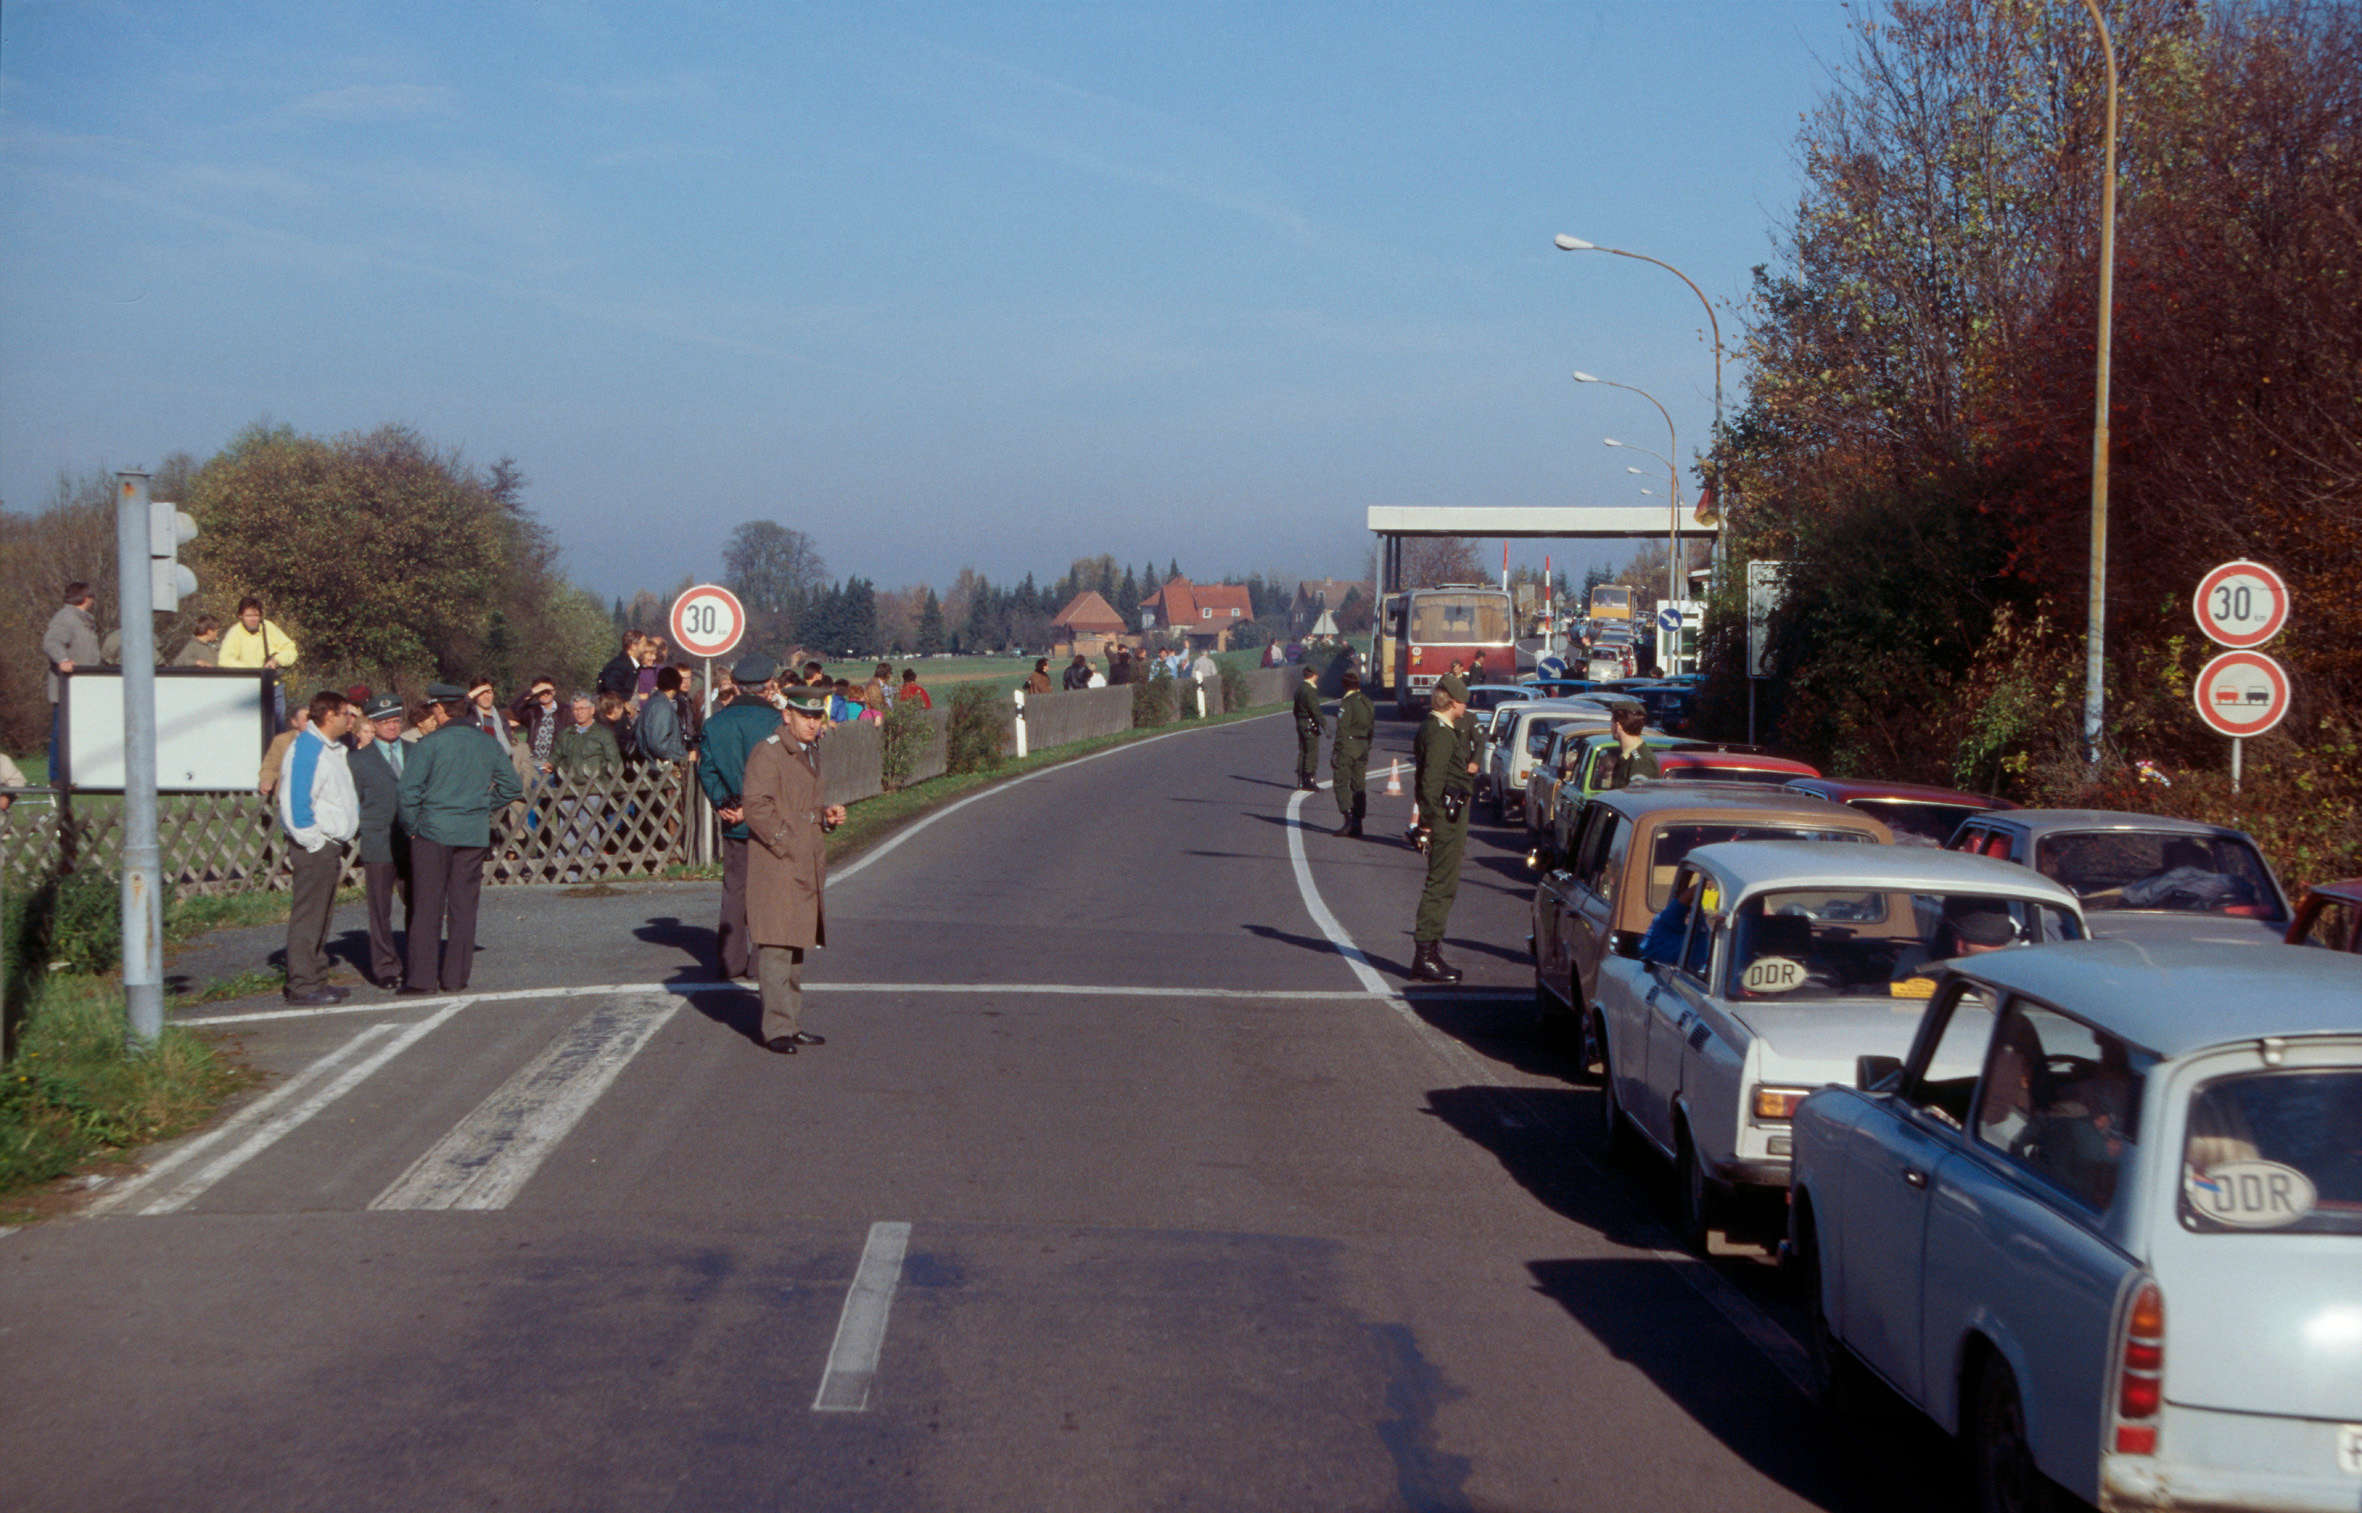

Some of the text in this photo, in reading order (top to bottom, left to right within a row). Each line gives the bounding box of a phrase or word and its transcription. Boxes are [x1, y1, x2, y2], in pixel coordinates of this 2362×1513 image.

[686, 604, 716, 634] 30
[2214, 586, 2250, 621] 30
[1750, 964, 1794, 986] DDR
[2213, 1173, 2295, 1213] DDR
